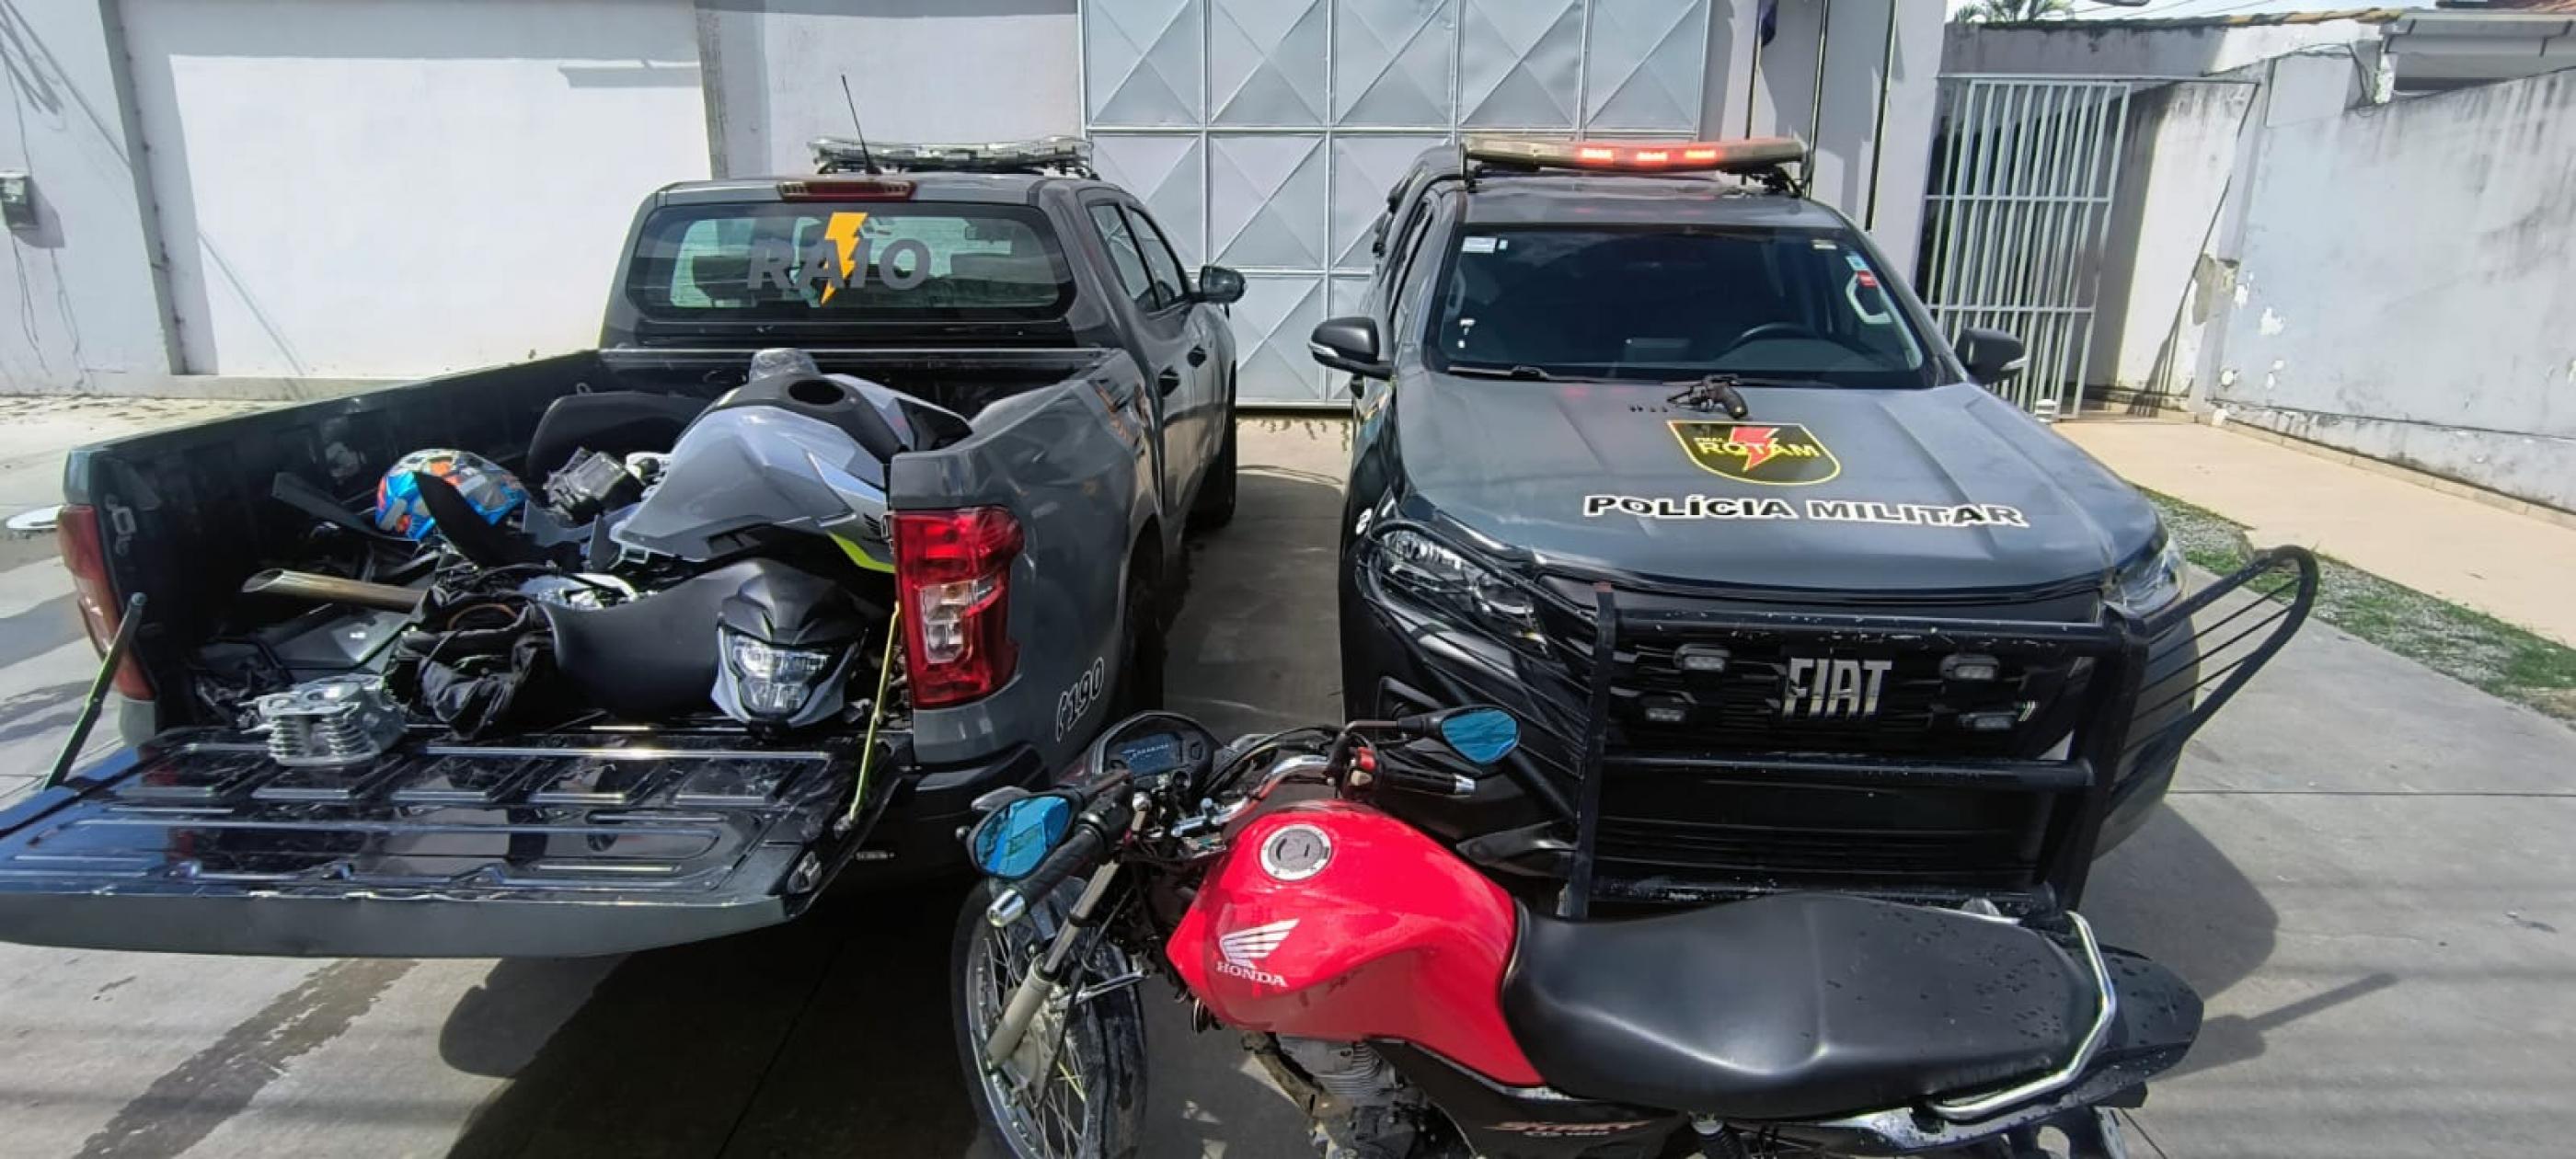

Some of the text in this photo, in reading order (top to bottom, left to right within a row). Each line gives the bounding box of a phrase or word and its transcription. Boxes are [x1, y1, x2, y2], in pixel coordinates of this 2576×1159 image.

[748, 237, 931, 290] RAIO
[1698, 442, 1822, 458] ROTAM
[1584, 495, 2030, 528] POLÍCIA MILITAR
[1068, 657, 1104, 732] 190
[1784, 658, 1892, 716] FIAT
[1216, 961, 1288, 987] HONDA
